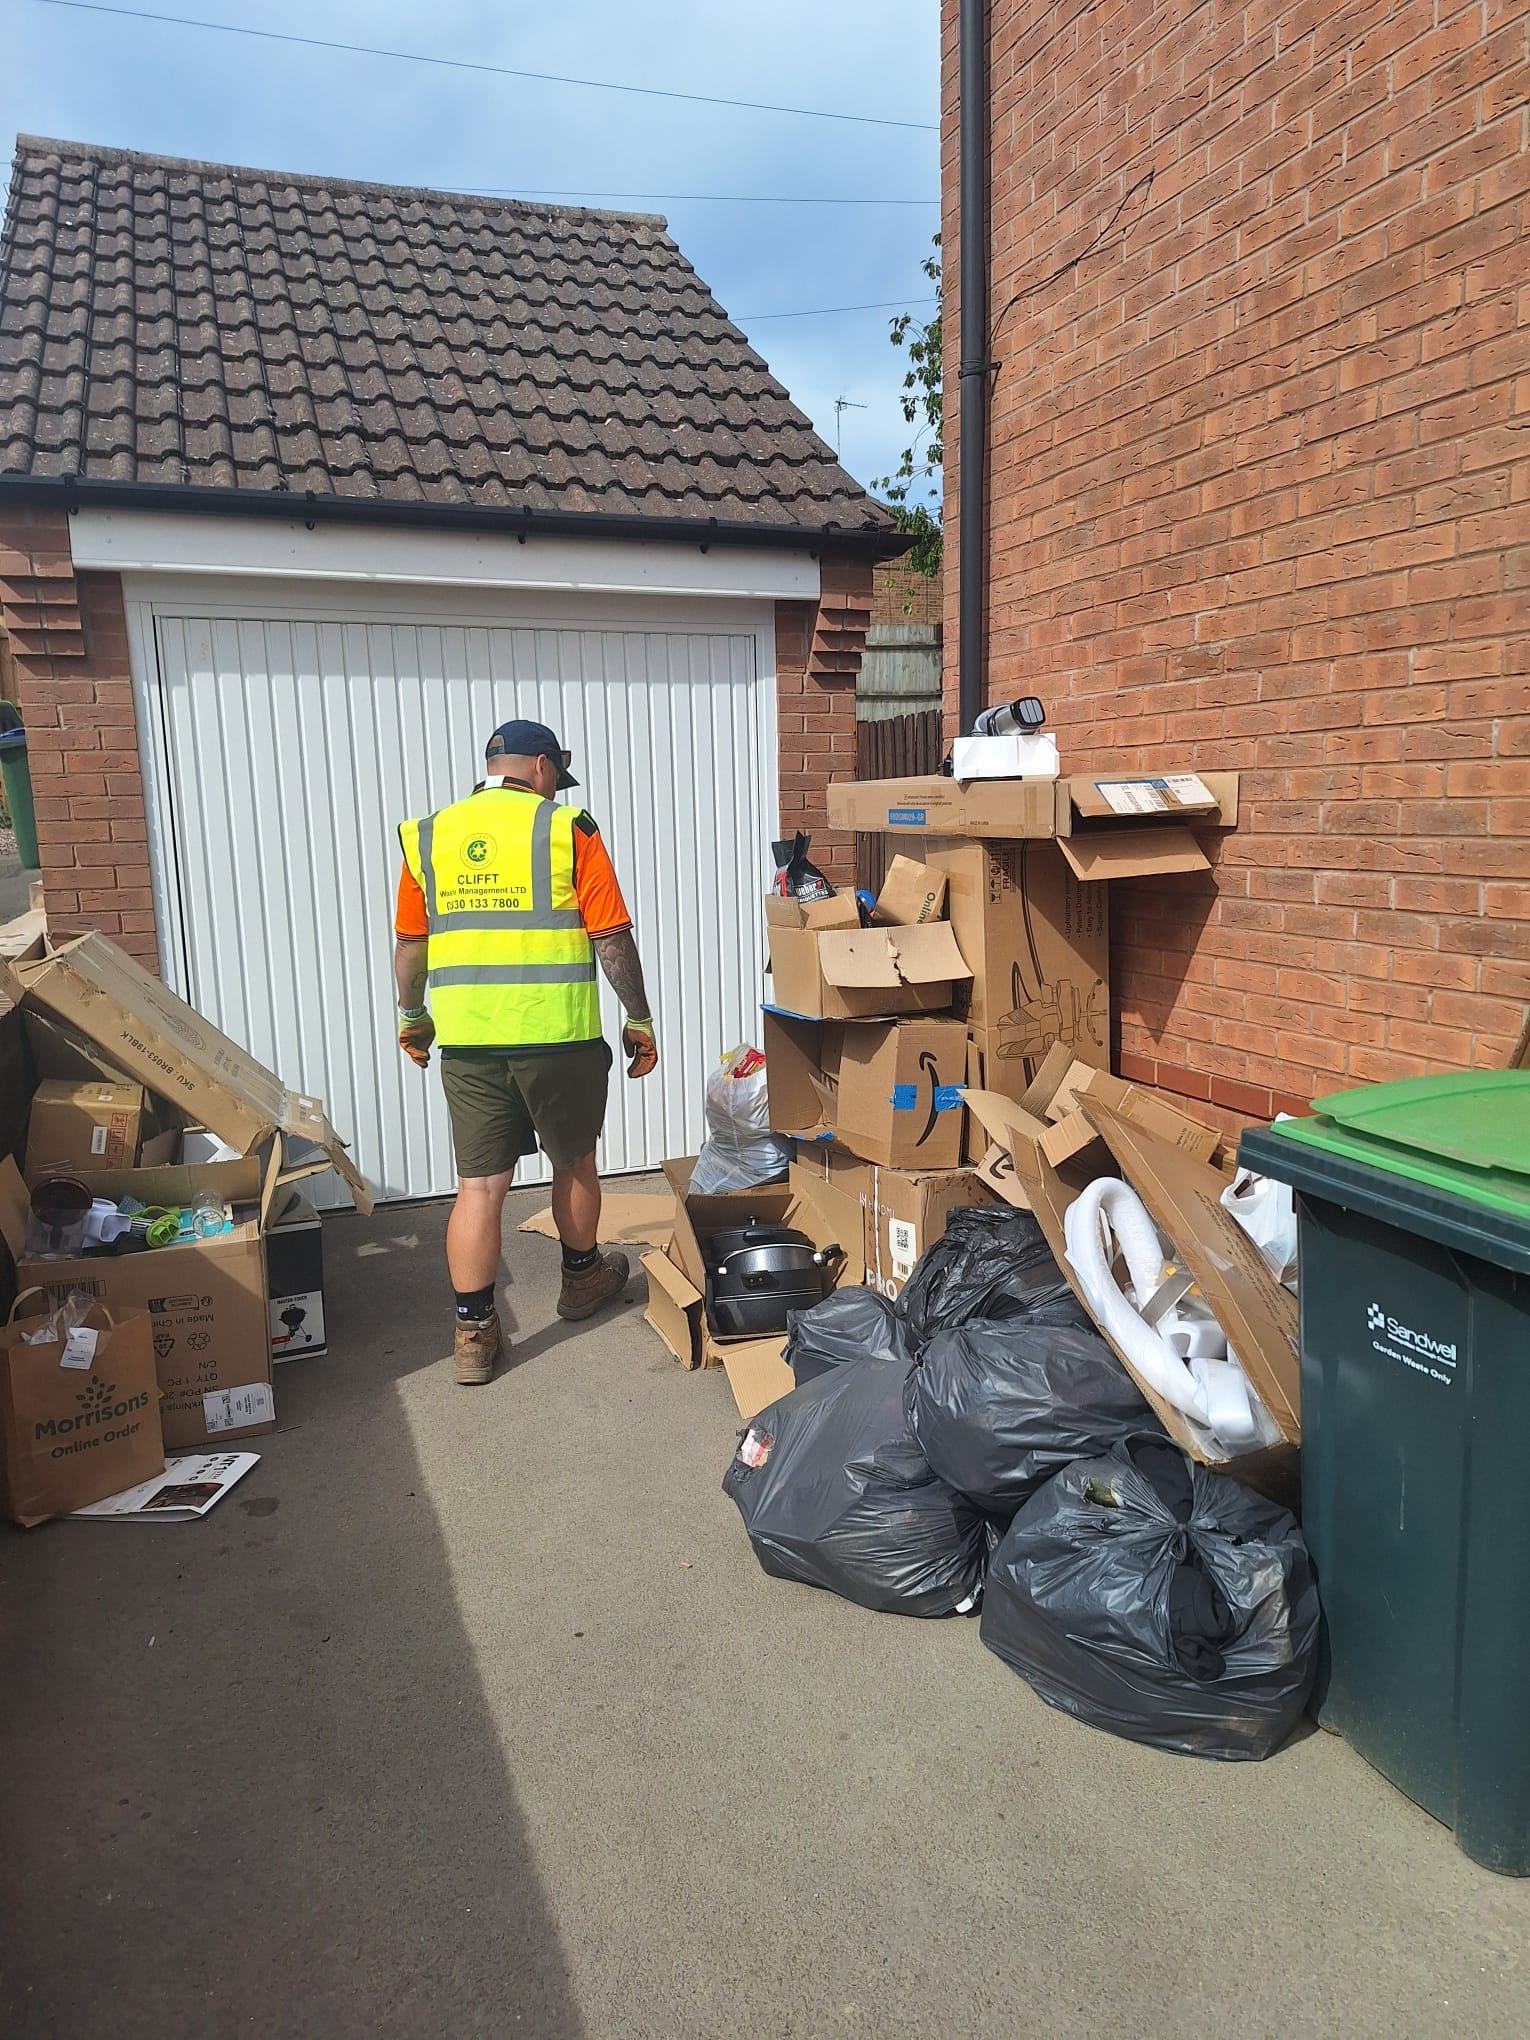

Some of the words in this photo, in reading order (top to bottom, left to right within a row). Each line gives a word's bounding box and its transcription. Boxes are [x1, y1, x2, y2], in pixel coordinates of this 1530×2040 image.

[457, 873, 500, 885] CLIFFT
[1002, 850, 1010, 889] FRAGILE
[458, 886, 509, 896] Management
[510, 886, 527, 894] LTD
[469, 898, 489, 909] 133
[491, 898, 520, 909] 7800
[120, 1030, 174, 1075] BR053-19BLK
[175, 1316, 184, 1325] in
[187, 1313, 214, 1324] Made
[1386, 1317, 1457, 1361] Sandwell
[1372, 1340, 1402, 1361] Garden
[1402, 1354, 1430, 1375] Waste
[1429, 1368, 1452, 1385] Only
[167, 1378, 182, 1387] PC
[35, 1391, 149, 1440] Morrisons
[51, 1438, 100, 1458] Online
[103, 1422, 141, 1442] Order
